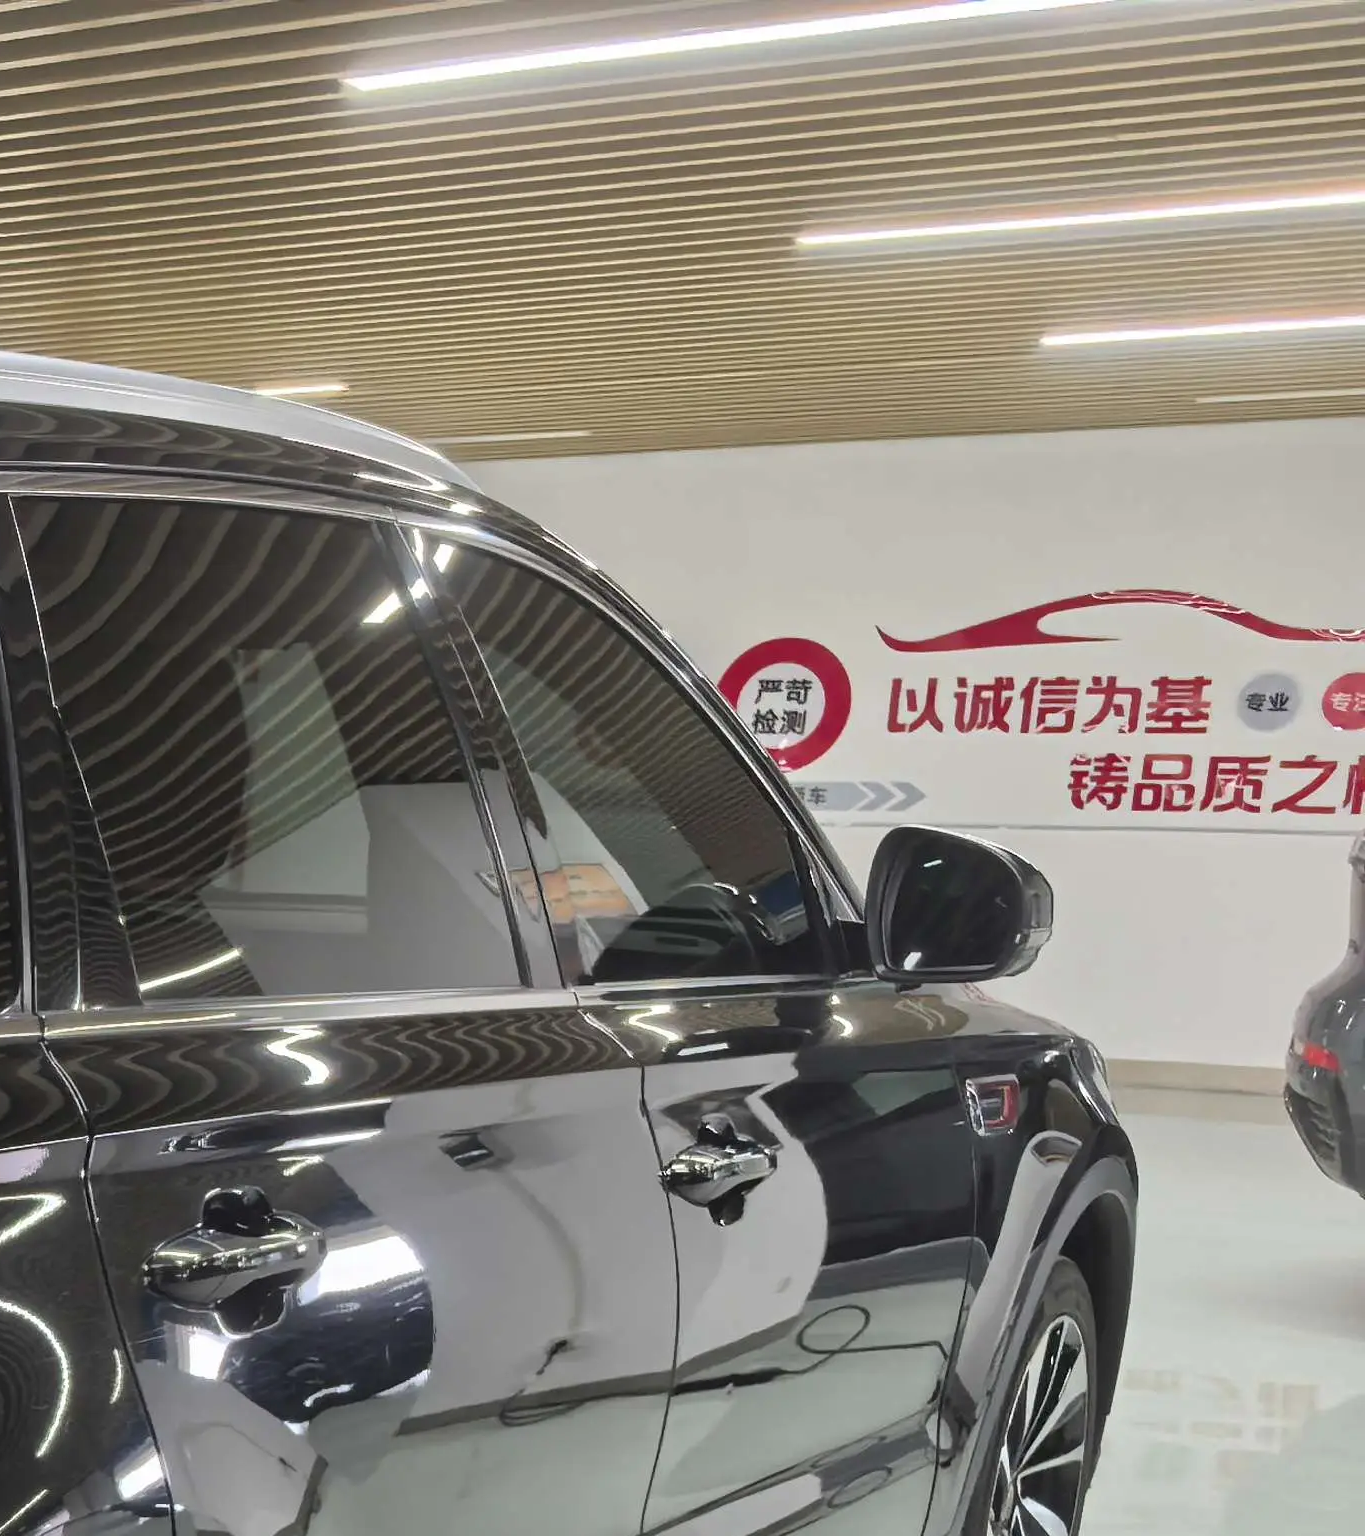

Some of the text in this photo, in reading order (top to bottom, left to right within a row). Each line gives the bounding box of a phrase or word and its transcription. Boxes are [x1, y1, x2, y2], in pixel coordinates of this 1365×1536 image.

[754, 678, 814, 705] 严苛
[1245, 692, 1290, 712] 专业
[886, 676, 1212, 735] 以诚信为基
[751, 709, 807, 735] 检测
